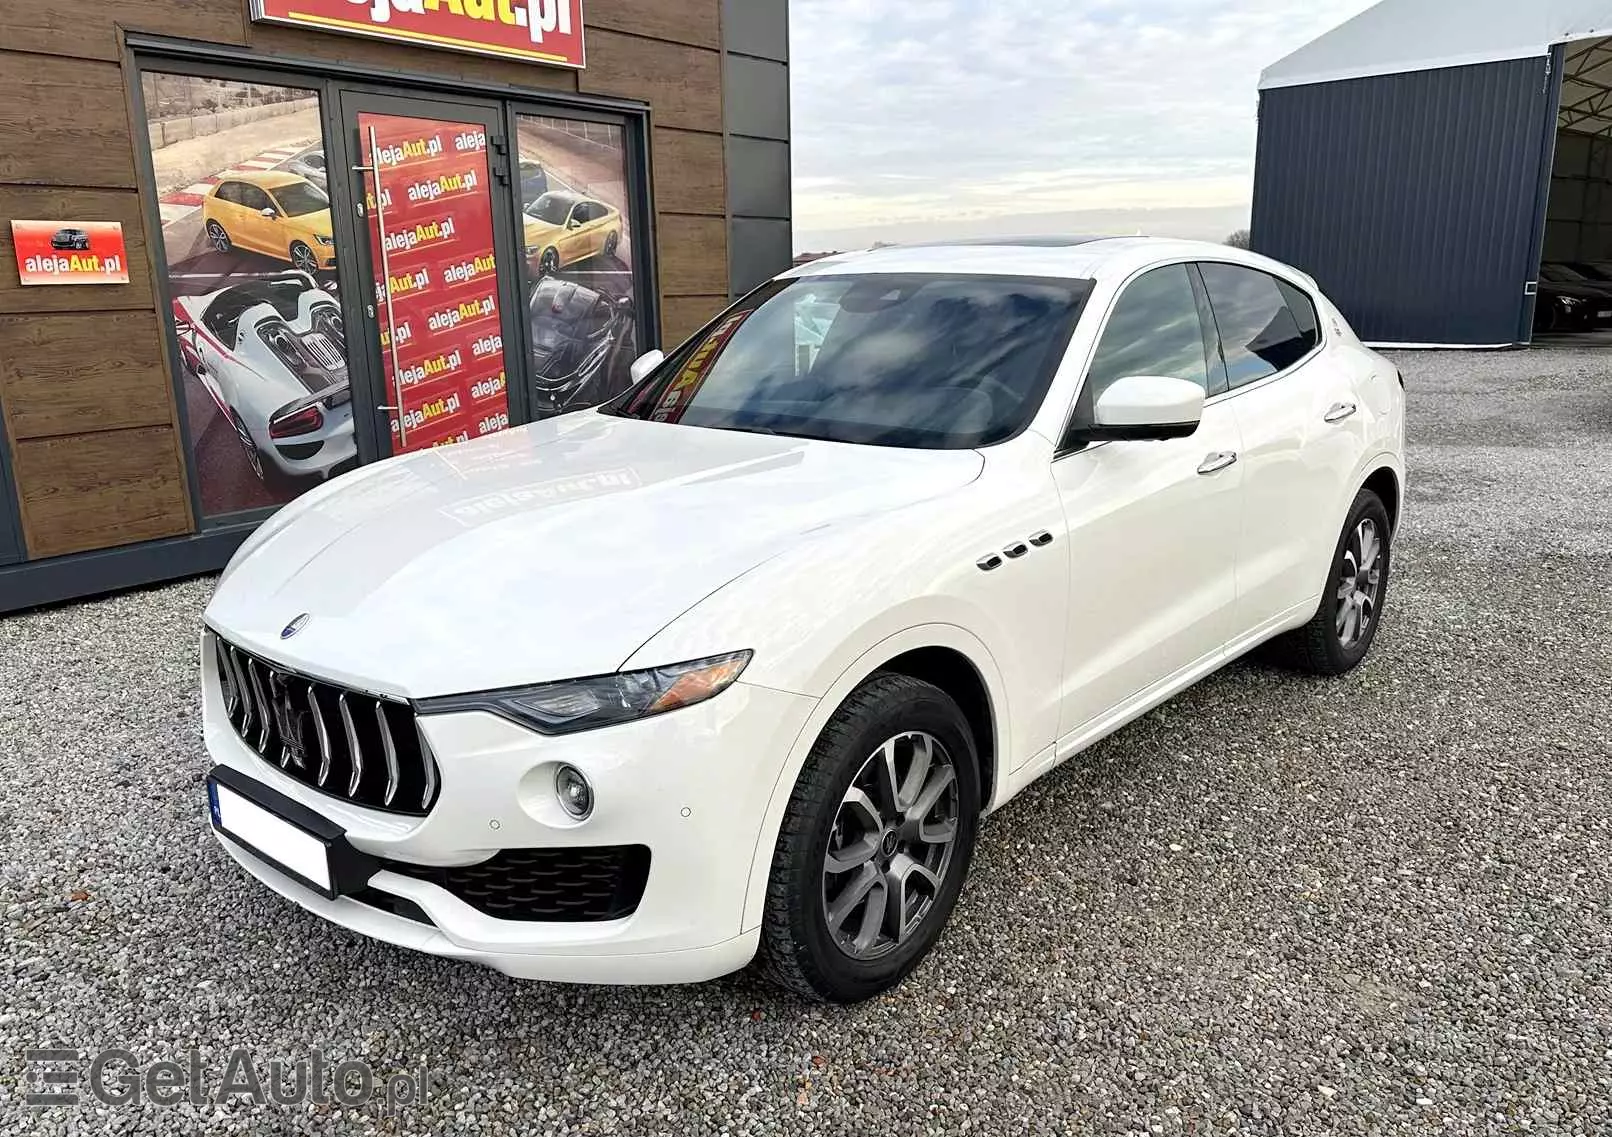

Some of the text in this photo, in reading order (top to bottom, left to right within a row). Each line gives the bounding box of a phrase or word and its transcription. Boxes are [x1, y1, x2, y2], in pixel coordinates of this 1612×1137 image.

[455, 131, 486, 150] aleja
[408, 170, 477, 200] alejaAut.pl
[384, 217, 454, 250] alejaAut.pl
[25, 254, 120, 275] alejaAut.pl
[444, 253, 496, 283] alejaAut
[428, 295, 496, 330] alejaAut.pl
[471, 335, 503, 356] aleja
[392, 350, 461, 386] lejaAut.pl
[390, 392, 460, 433] aejaAut.pl
[479, 412, 509, 434] aleja
